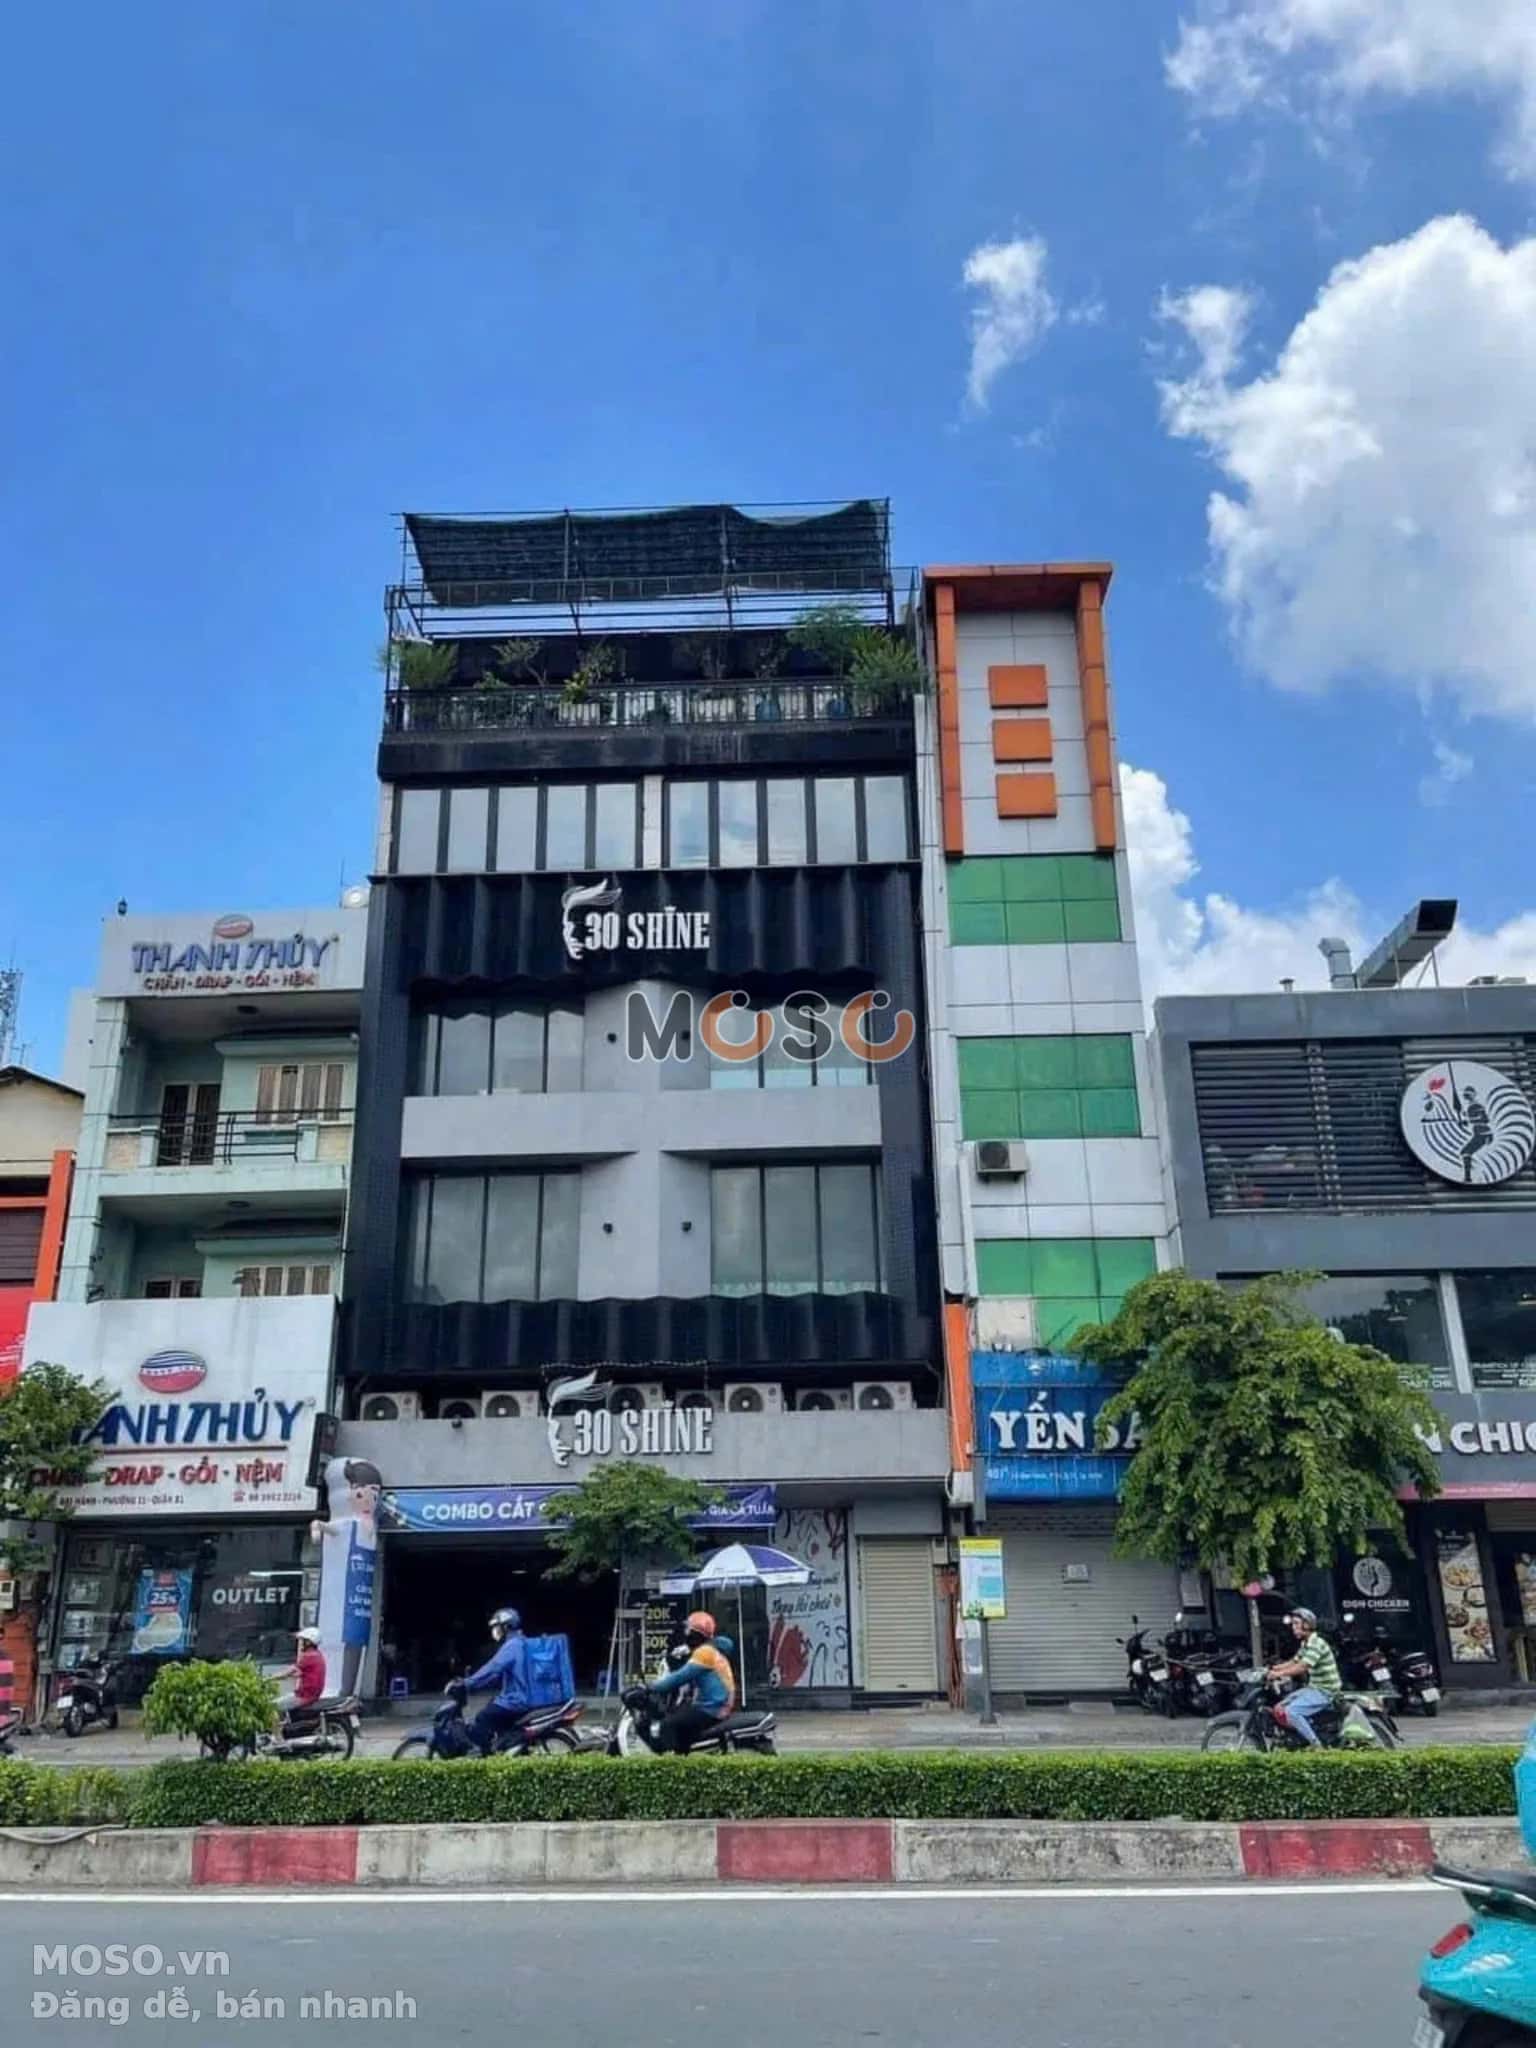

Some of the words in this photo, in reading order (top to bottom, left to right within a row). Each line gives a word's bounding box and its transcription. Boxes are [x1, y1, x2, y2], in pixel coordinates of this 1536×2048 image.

[583, 911, 620, 950] 30
[627, 905, 711, 950] SHINE
[131, 940, 240, 974] THANH
[244, 933, 331, 970] THỦY
[70, 1402, 182, 1445] ANH
[182, 1388, 304, 1444] THỦY
[573, 1408, 612, 1456] 30
[620, 1401, 714, 1455] SHINE
[989, 1391, 1087, 1450] YẾN
[179, 1455, 218, 1485] GỐI
[236, 1458, 283, 1489] NỆM
[421, 1501, 491, 1521] COMBO
[497, 1494, 534, 1520] CẮT
[212, 1586, 290, 1605] OUTLET
